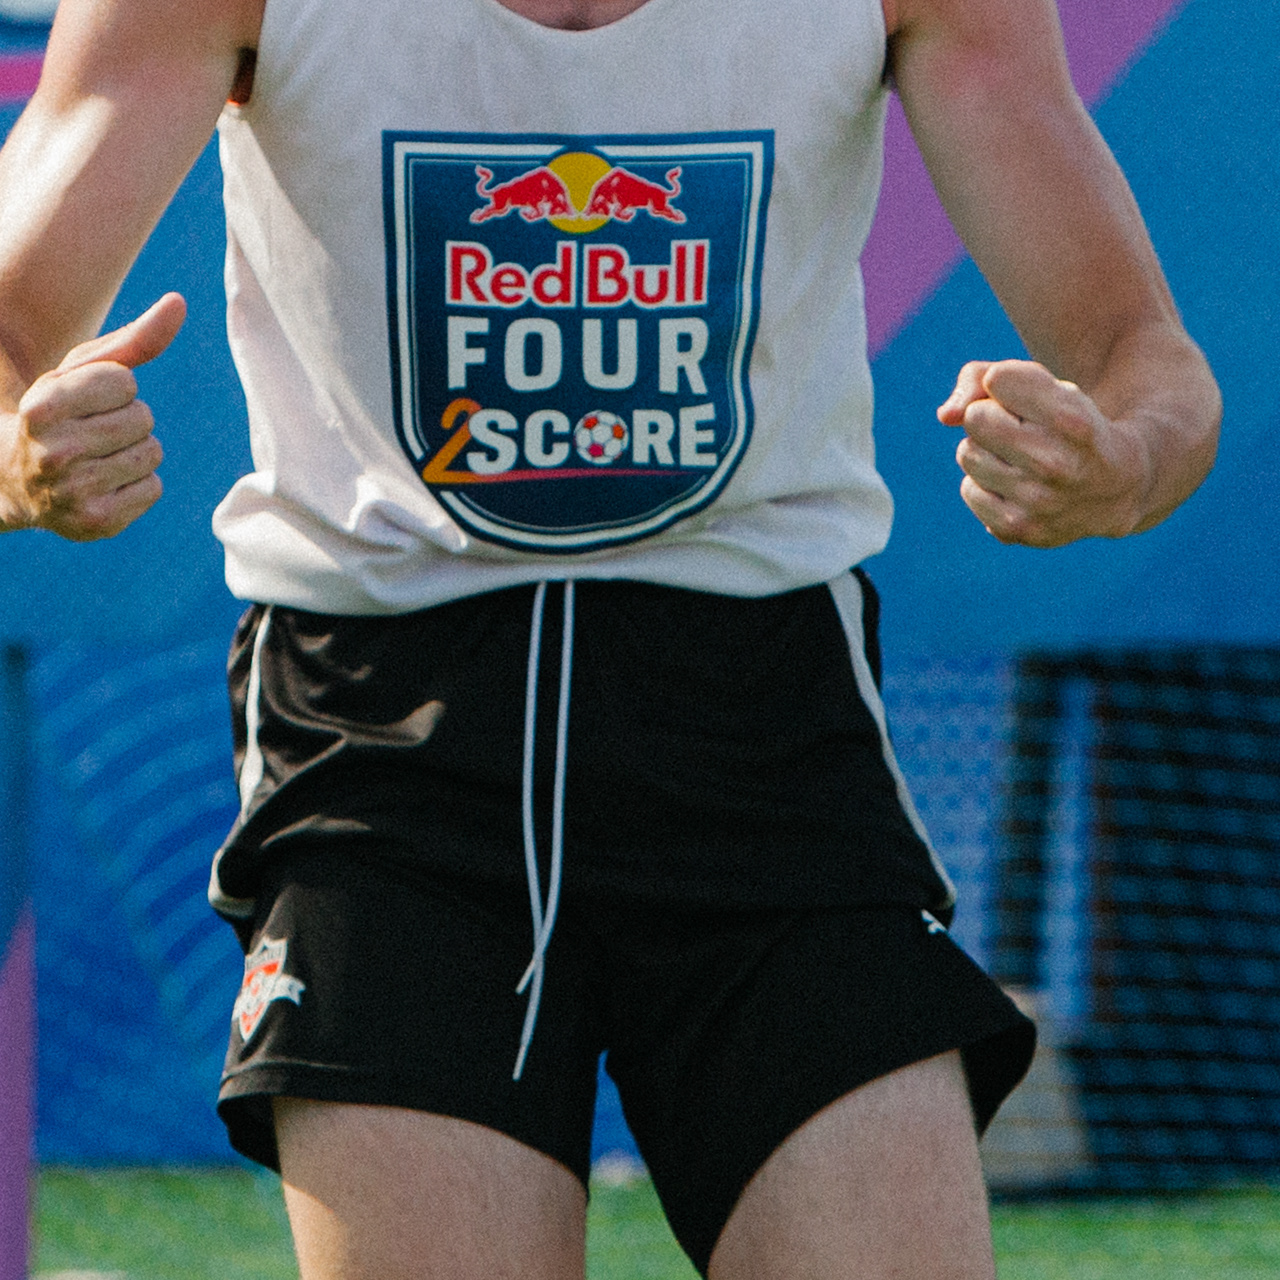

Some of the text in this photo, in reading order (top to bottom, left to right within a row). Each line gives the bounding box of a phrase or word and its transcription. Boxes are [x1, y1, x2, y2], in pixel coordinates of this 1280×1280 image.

[449, 242, 707, 306] Red Bull
[446, 315, 710, 396] FOUR
